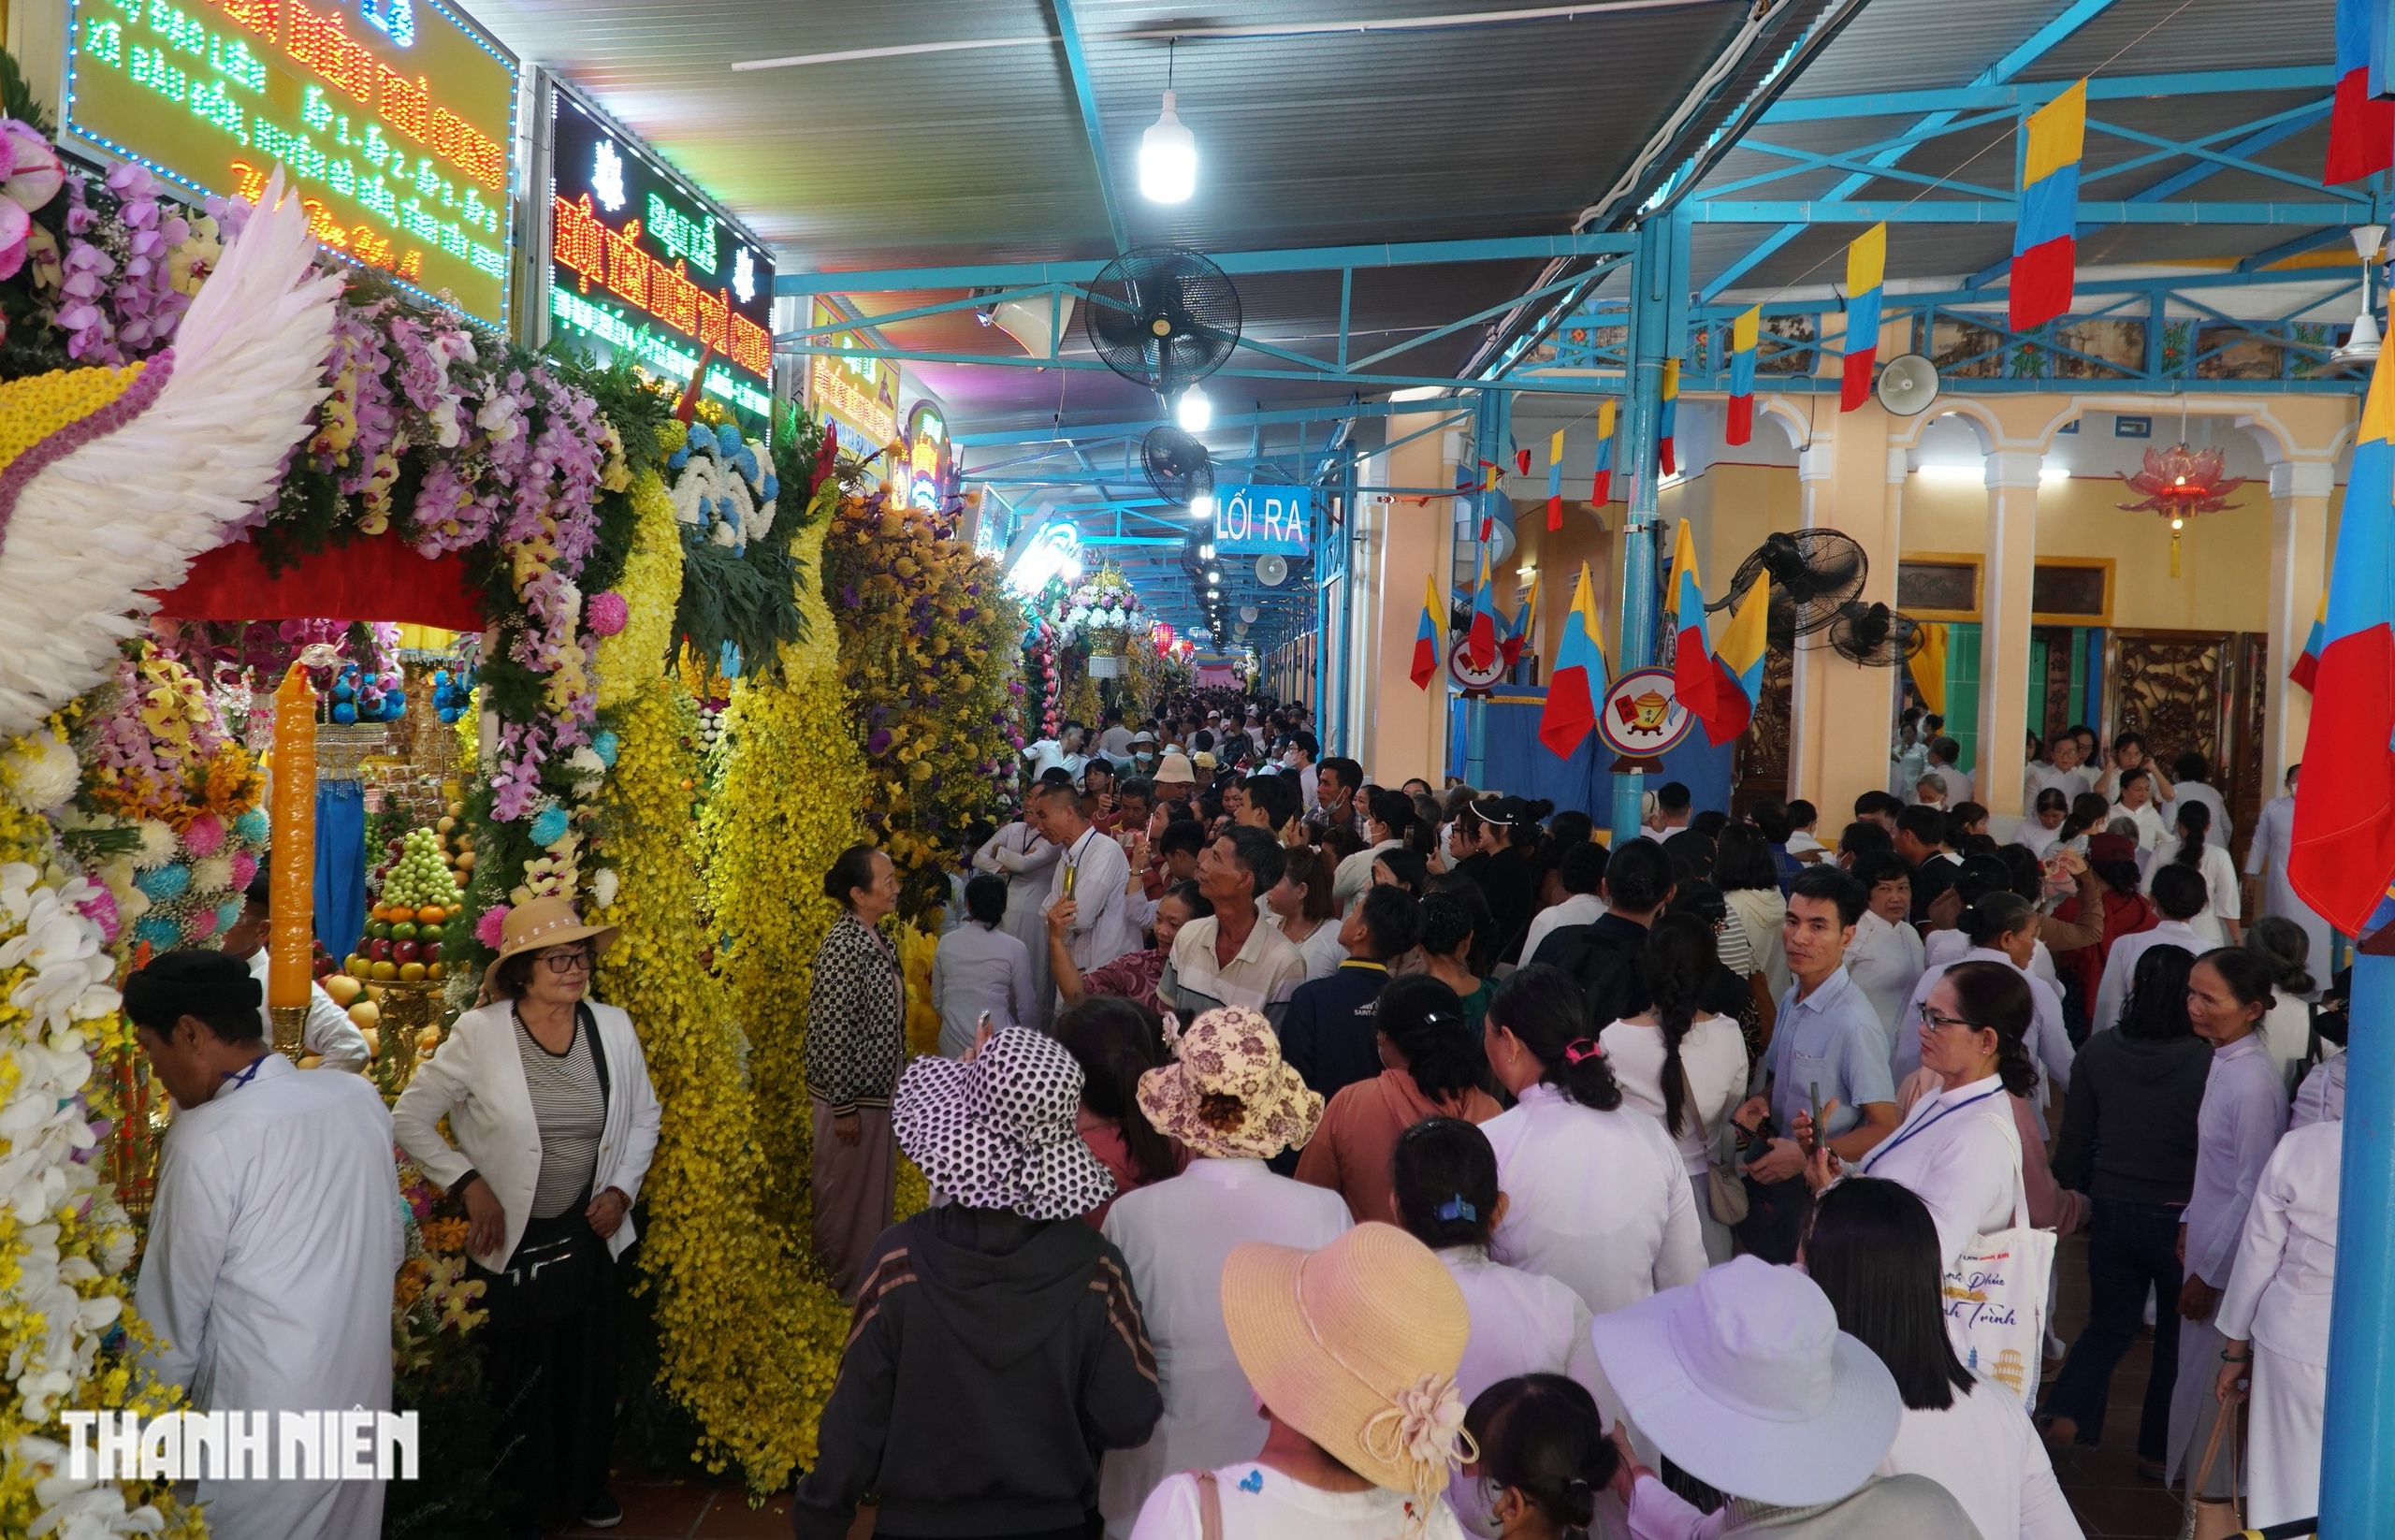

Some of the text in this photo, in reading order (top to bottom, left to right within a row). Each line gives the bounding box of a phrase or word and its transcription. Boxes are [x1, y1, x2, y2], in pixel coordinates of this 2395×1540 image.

[432, 106, 503, 191] CUNG
[1216, 487, 1303, 542] LỐI RA
